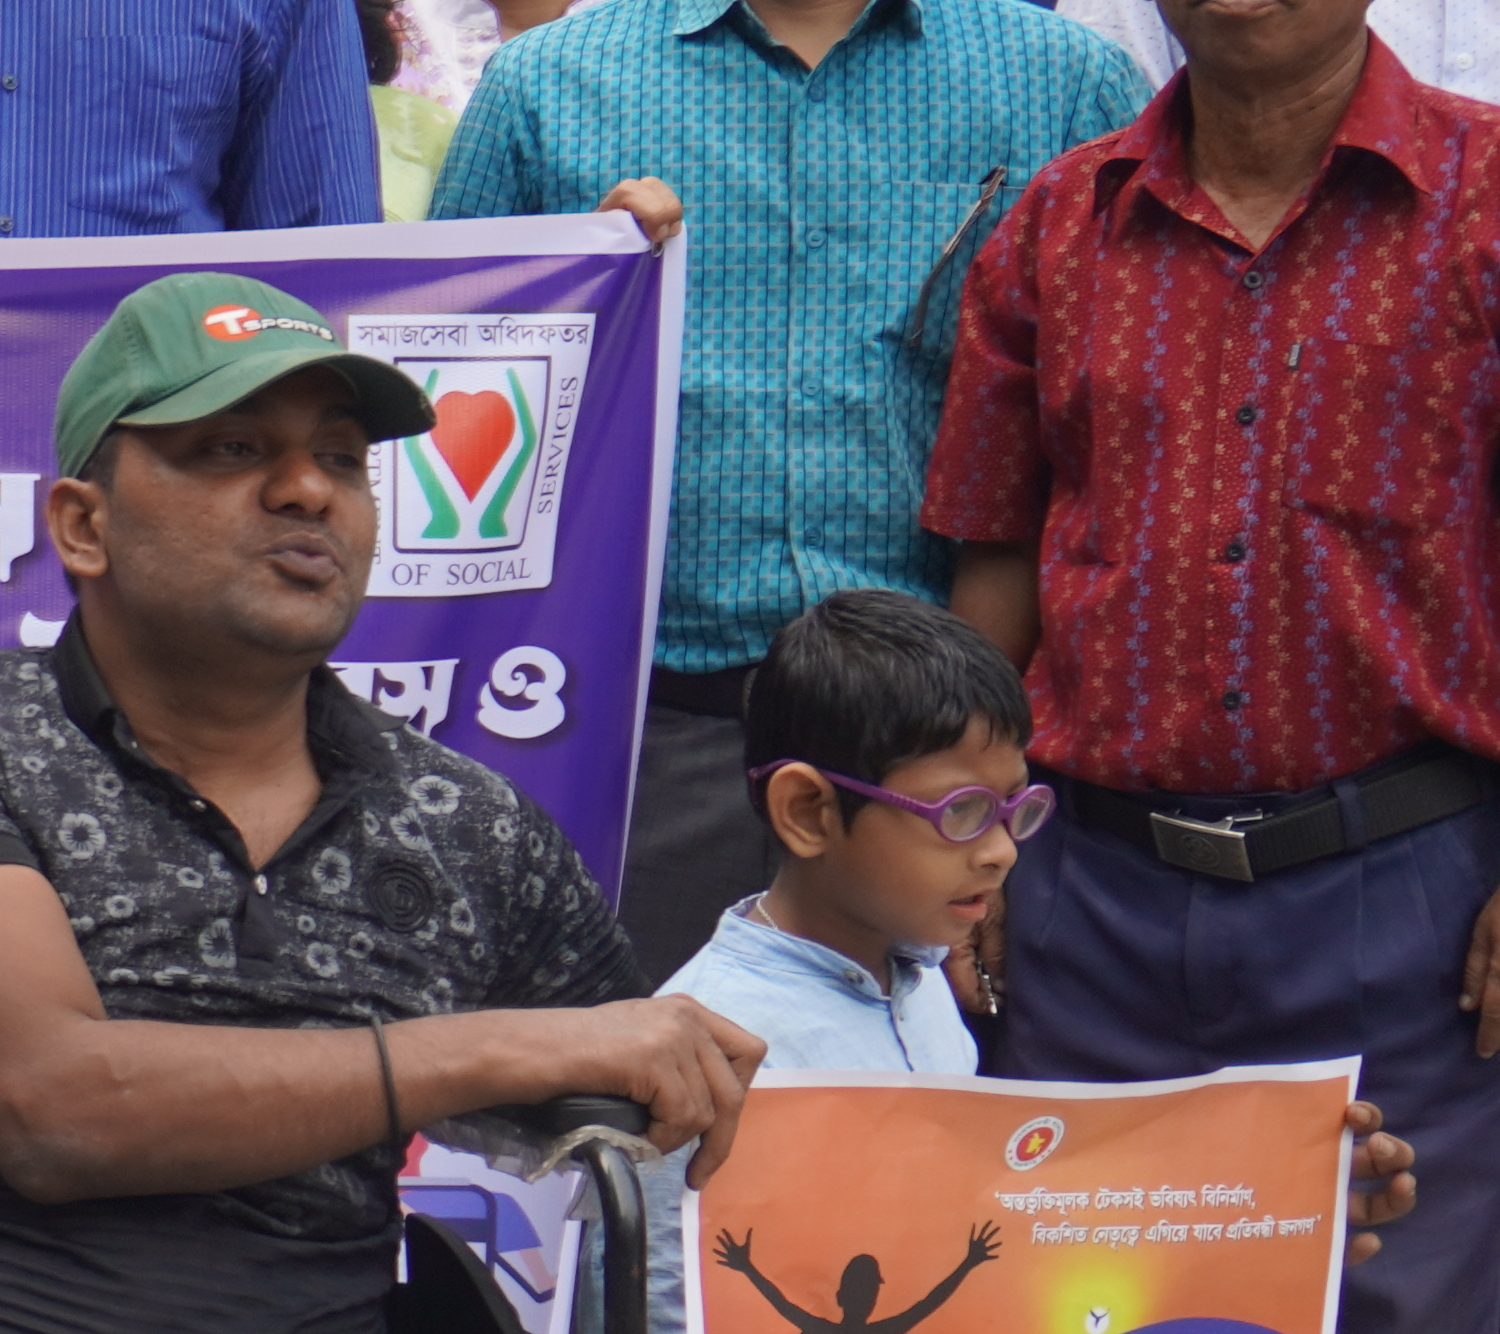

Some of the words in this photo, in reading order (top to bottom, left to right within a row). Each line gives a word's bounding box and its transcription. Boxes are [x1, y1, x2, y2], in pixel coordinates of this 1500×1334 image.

[244, 318, 333, 341] SPORTS
[358, 324, 468, 346] সমাজসেবা
[477, 317, 590, 344] অধিদফতর
[537, 376, 578, 514] SERVICES
[392, 564, 430, 585] OF
[446, 558, 531, 585] SOCIAL
[477, 645, 567, 740] ও
[1094, 1187, 1146, 1210] টেকসই
[1148, 1184, 1197, 1209] ভবিষ্যৎ
[1032, 1221, 1089, 1245] বিকশিত
[1092, 1226, 1142, 1250] নেতৃত্বে
[1145, 1219, 1188, 1243] এগিয়ে
[1193, 1223, 1223, 1242] যাবে
[1226, 1214, 1274, 1241] প্রতিবন্ধী
